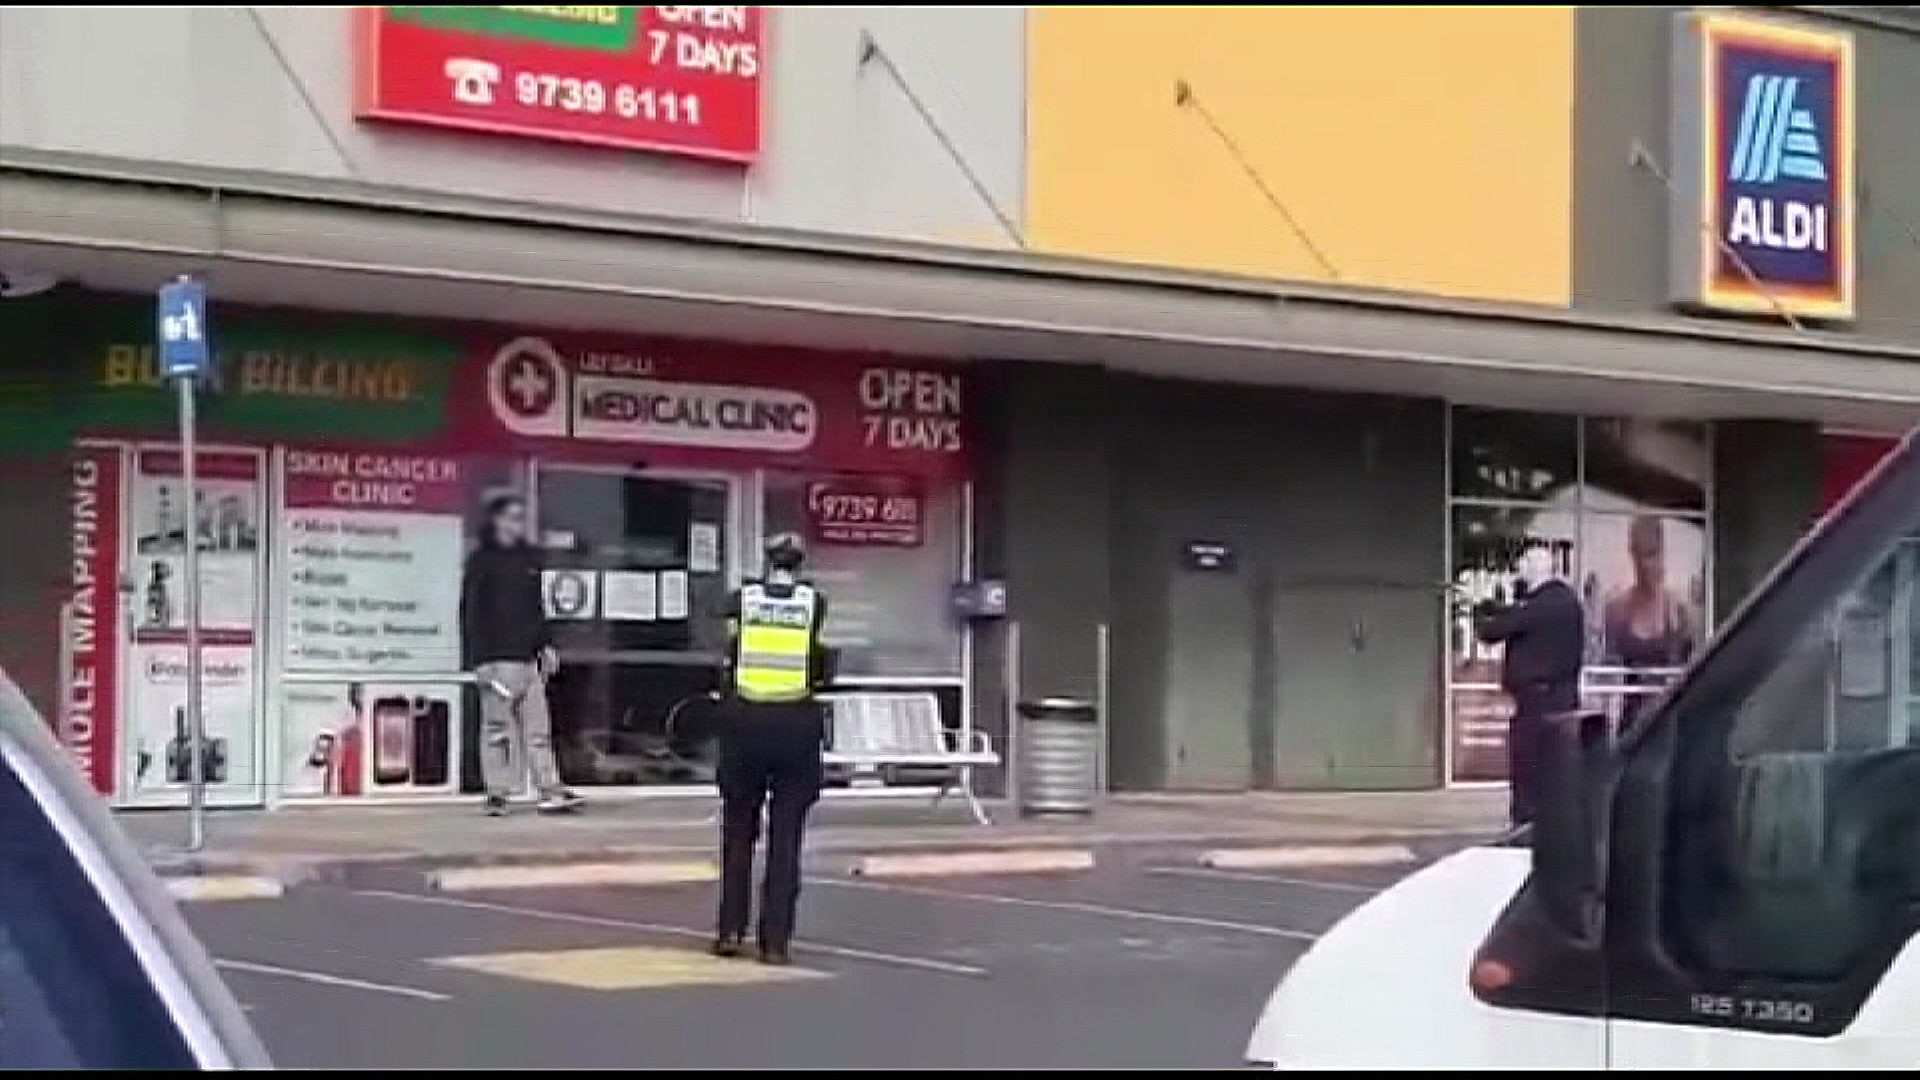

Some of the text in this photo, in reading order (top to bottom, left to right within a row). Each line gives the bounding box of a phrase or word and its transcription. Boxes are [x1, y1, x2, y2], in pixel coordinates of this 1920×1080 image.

[648, 29, 758, 78] 7 DAYS
[515, 71, 701, 125] 9739 6111
[1728, 195, 1829, 252] ALDI
[580, 388, 811, 434] MEDICAL CLINIC
[858, 367, 962, 415] OPEN
[863, 415, 962, 452] 7 DAYS
[286, 451, 350, 475] SKIN
[332, 479, 417, 505] CLINIC
[71, 459, 98, 653] MAPPING
